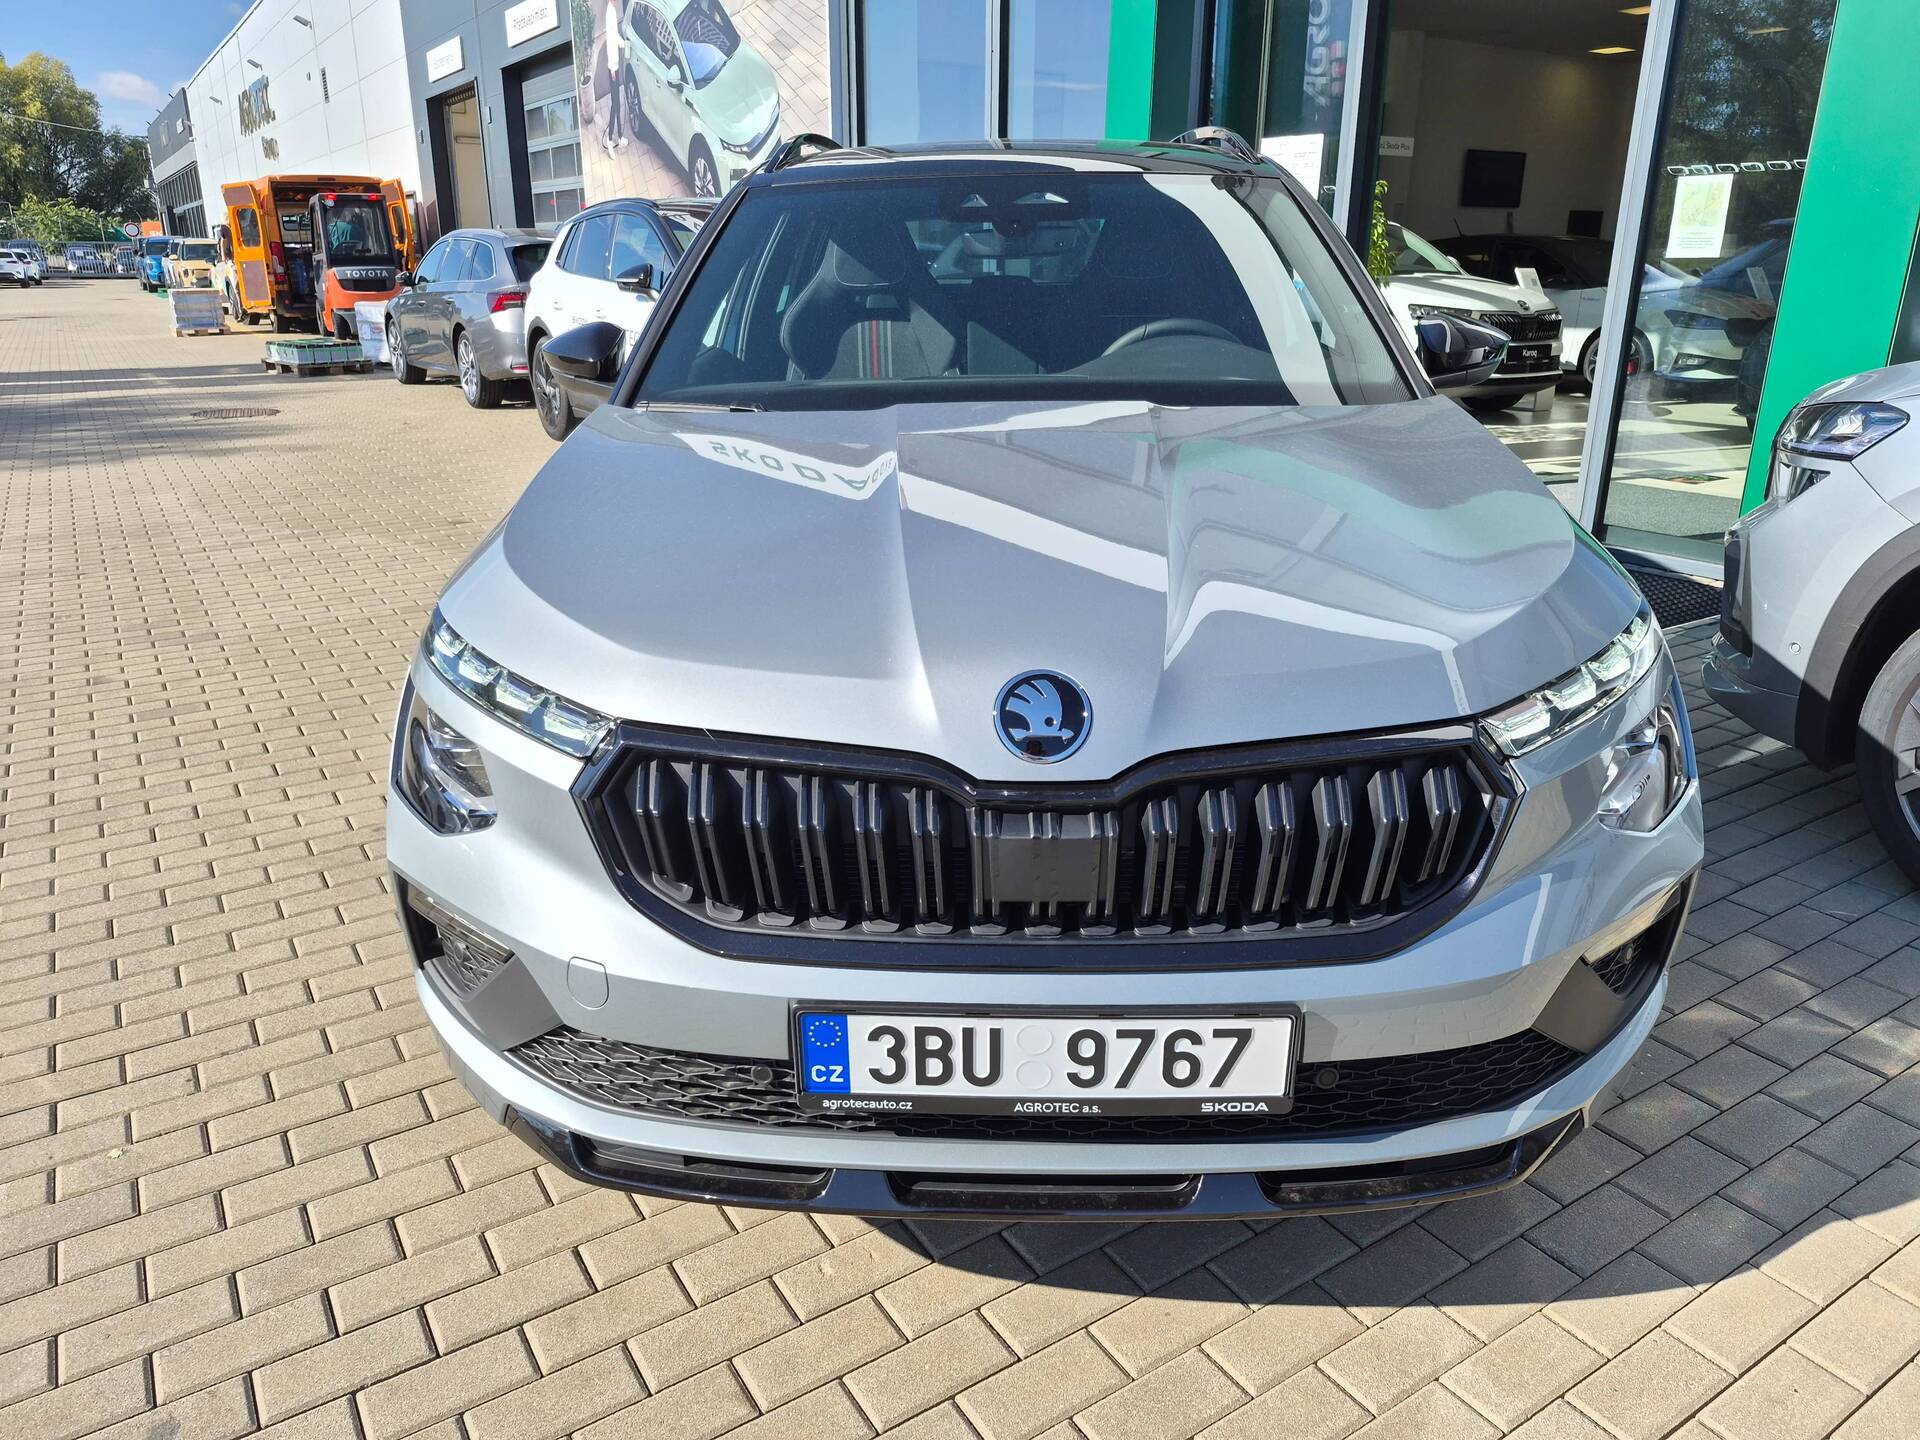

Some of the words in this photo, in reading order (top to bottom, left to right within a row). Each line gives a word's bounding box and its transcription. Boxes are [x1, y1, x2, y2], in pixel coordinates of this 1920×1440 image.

[345, 270, 389, 278] TOYOTA
[1522, 348, 1538, 358] Karoq
[867, 1025, 1002, 1087] 3BU
[1066, 1028, 1253, 1088] 9767
[811, 1065, 844, 1083] CZ
[822, 1099, 913, 1111] agrotecauto.cz
[1014, 1102, 1080, 1113] AGROTEC
[1082, 1104, 1102, 1113] a.s.
